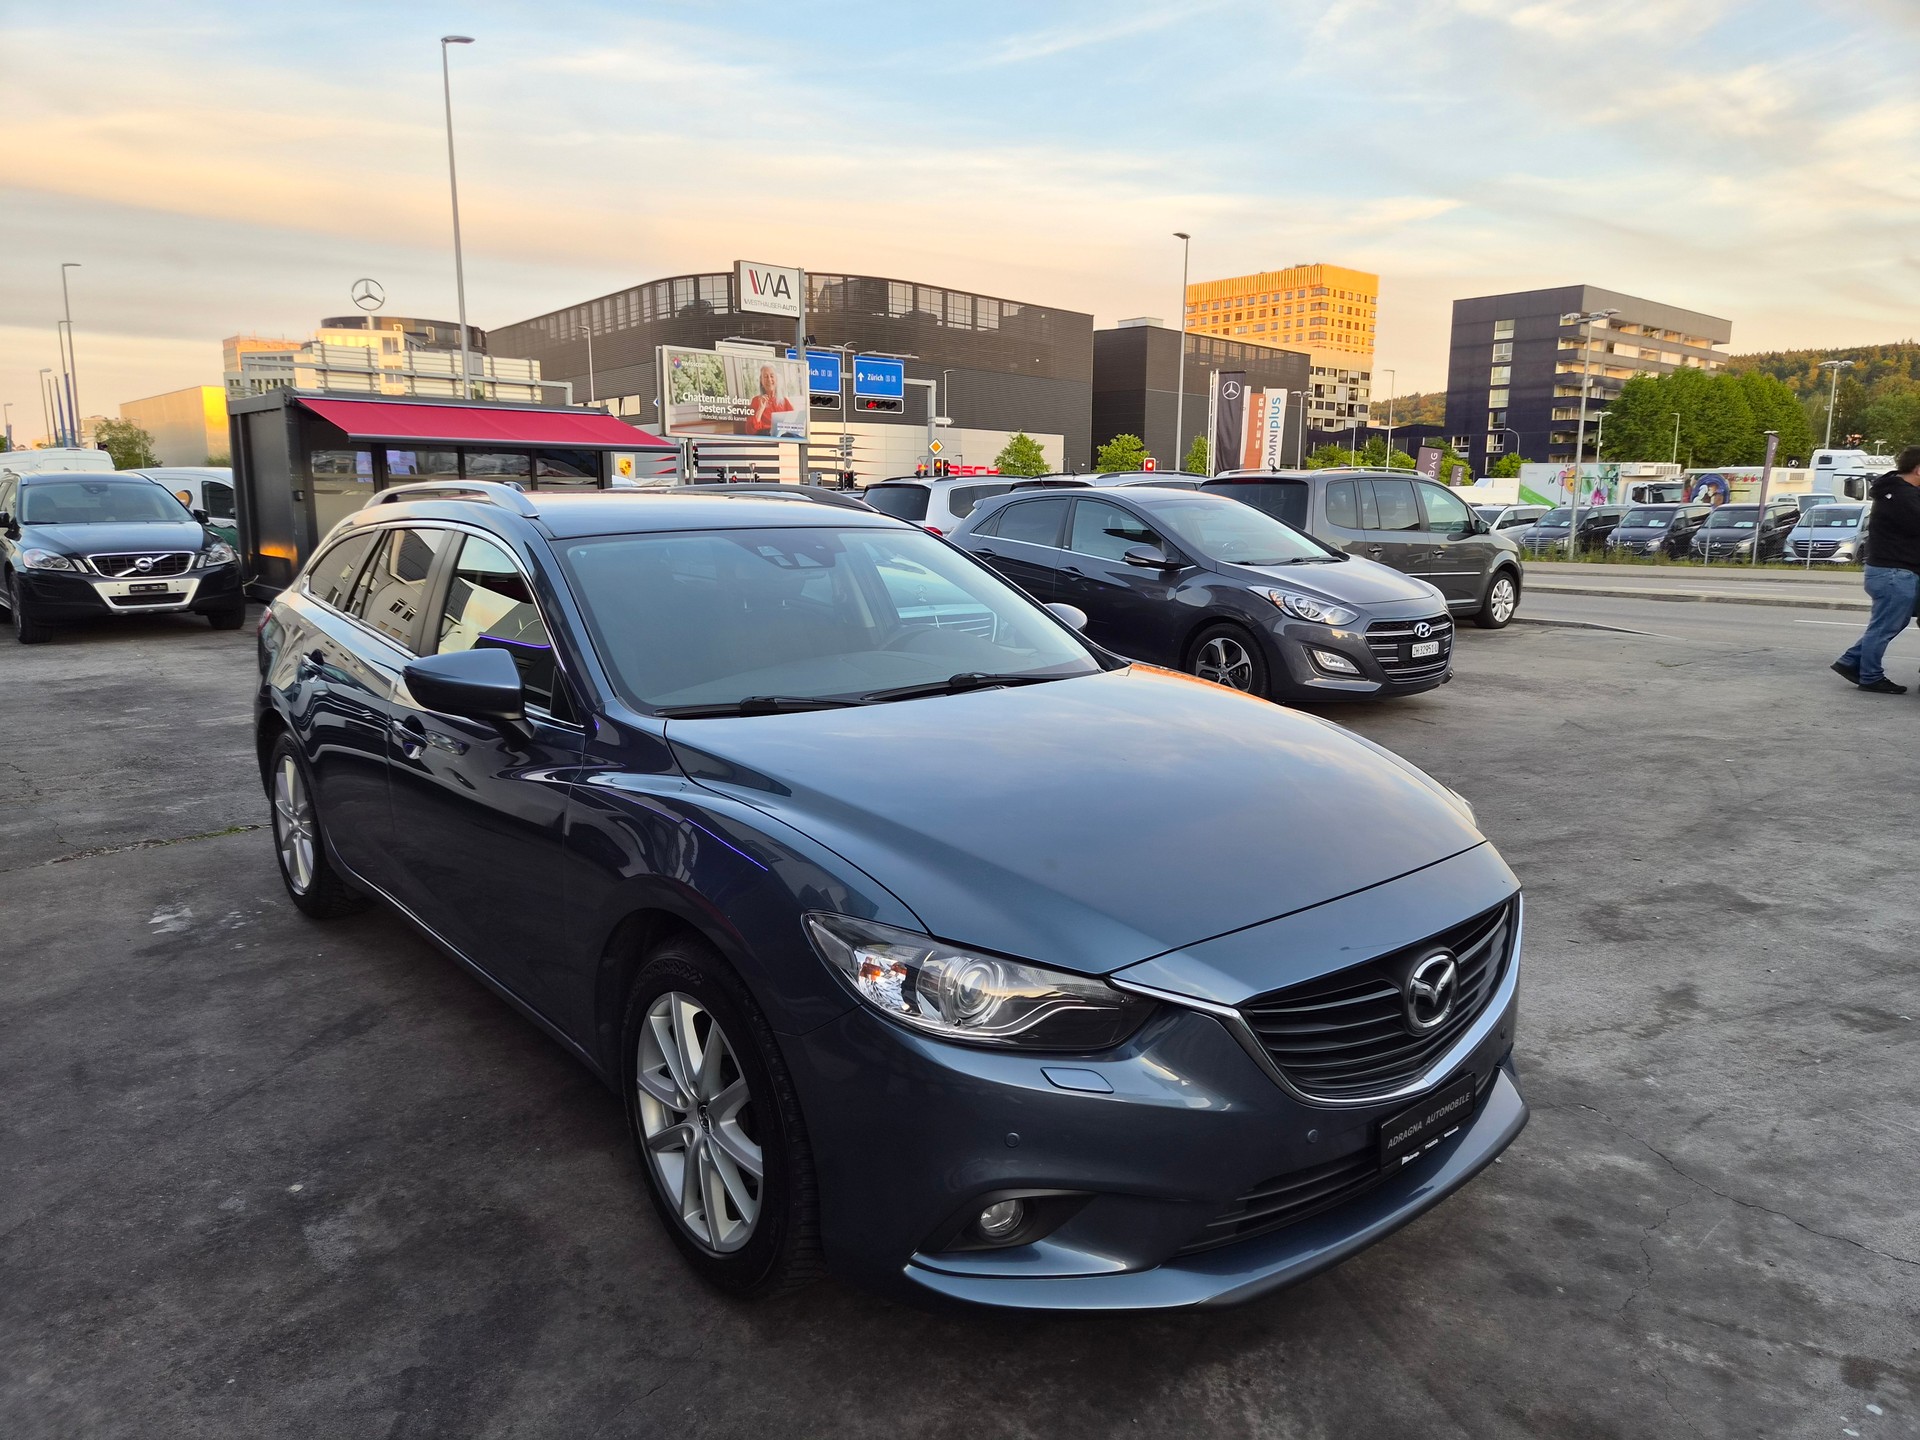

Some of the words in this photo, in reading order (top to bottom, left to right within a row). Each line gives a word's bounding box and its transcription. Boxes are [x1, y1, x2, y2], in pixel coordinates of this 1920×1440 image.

[867, 373, 884, 382] Zürich
[682, 391, 715, 403] Chatten
[717, 394, 731, 404] mit
[732, 395, 751, 405] dem
[698, 403, 726, 414] besten
[727, 405, 755, 416] Service
[1387, 1121, 1423, 1150] ADRAGNA
[1425, 1092, 1471, 1126] AUTOMOBILE
